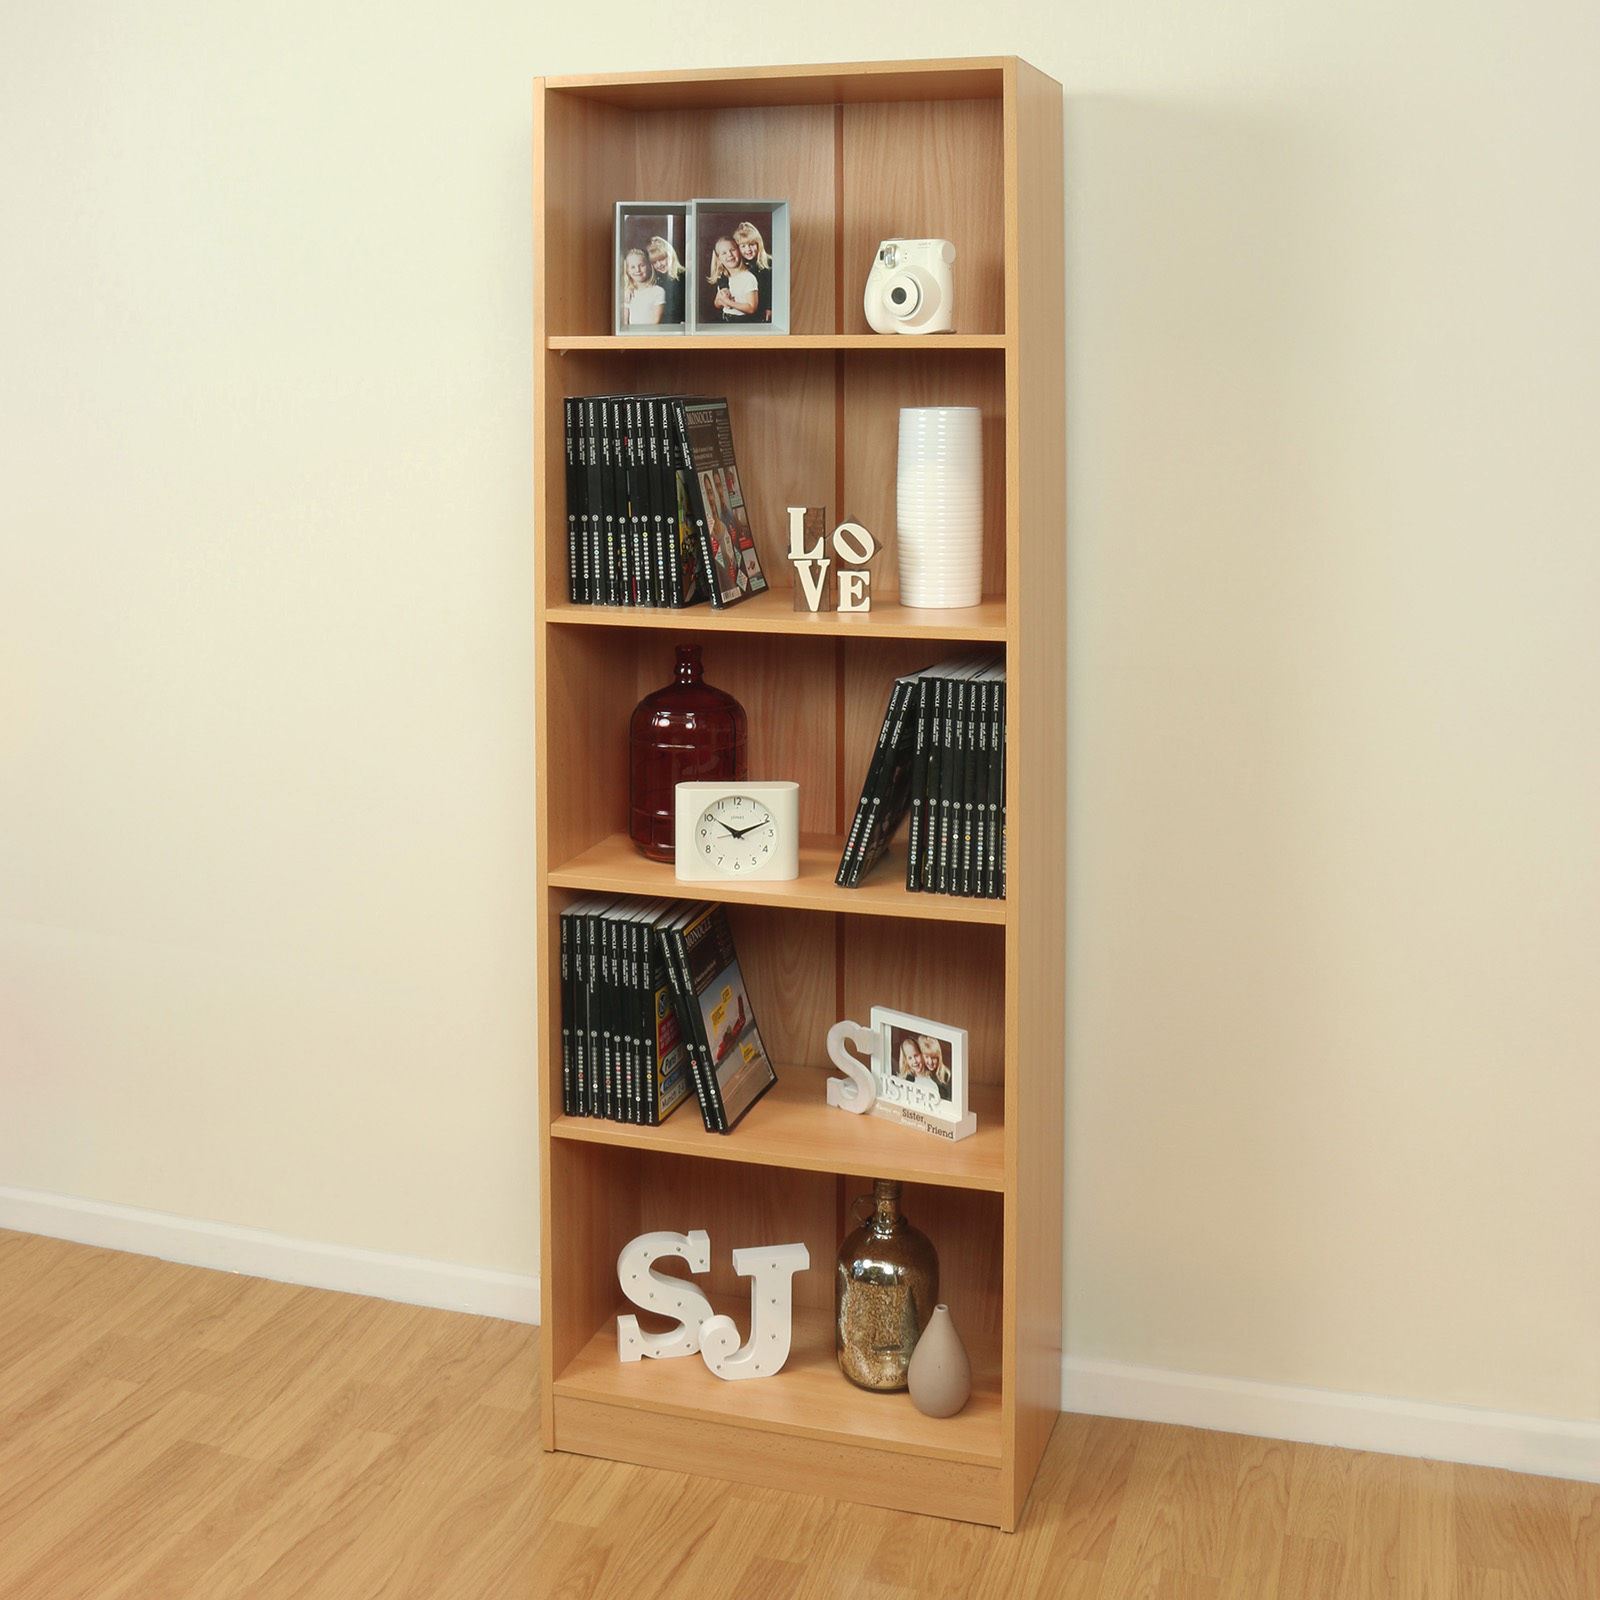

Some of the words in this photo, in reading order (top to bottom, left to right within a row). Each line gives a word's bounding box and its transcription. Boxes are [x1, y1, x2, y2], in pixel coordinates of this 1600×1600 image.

[676, 407, 684, 432] MONOCLE
[734, 797, 741, 806] 12
[718, 802, 724, 810] 11
[764, 814, 770, 822] 2
[701, 829, 707, 838] 9
[717, 857, 723, 865] 7
[752, 857, 757, 865] 5
[734, 862, 740, 870] 6
[927, 1124, 954, 1139] Friend
